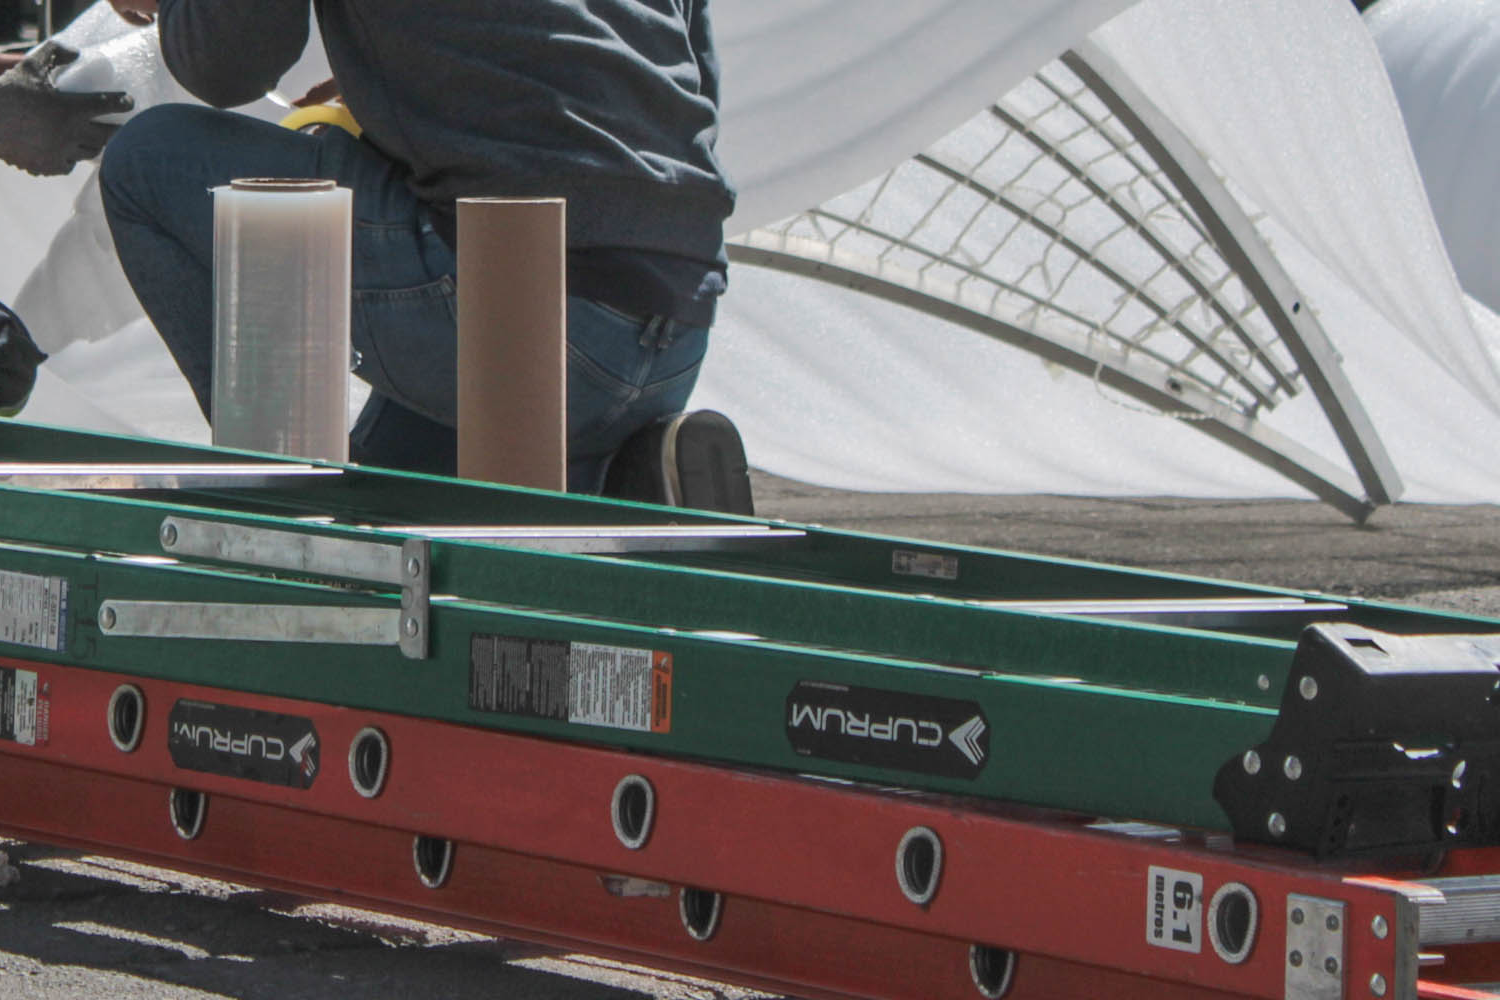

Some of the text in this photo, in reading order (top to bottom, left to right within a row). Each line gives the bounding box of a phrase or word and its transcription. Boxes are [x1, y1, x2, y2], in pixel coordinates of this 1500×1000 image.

[791, 703, 943, 747] CUPRUM
[1154, 874, 1165, 939] metros
[1173, 880, 1194, 944] 6.1
